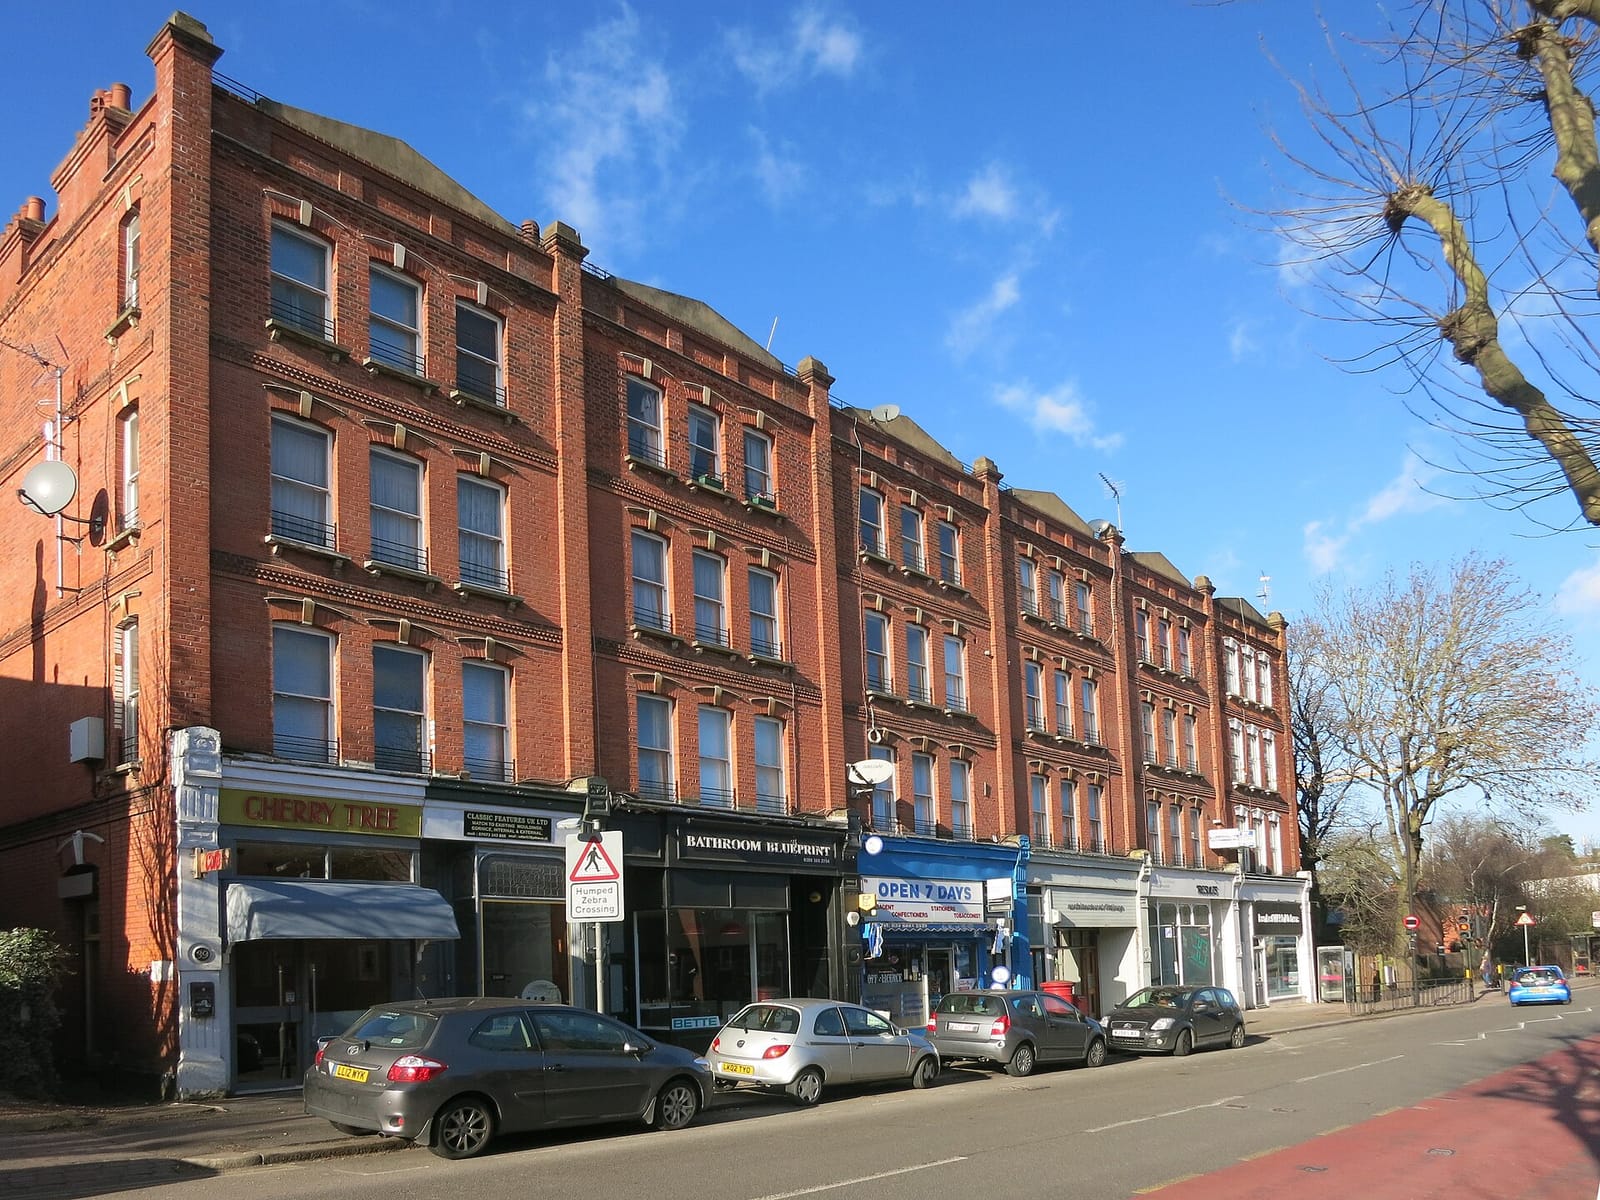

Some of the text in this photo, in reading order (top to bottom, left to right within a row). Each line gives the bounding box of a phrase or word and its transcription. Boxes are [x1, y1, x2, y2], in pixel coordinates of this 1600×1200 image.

[244, 796, 398, 830] CHERRY TREE
[467, 812, 493, 821] CLASSIC
[494, 815, 525, 824] FEATURES
[686, 835, 831, 857] BATHROOM BLUEPRINT
[575, 886, 613, 896] Humped
[878, 882, 972, 900] OPEN 7 DAYS
[581, 896, 608, 905] Zebra
[575, 905, 615, 914] Crossing
[673, 1018, 719, 1028] BETTE
